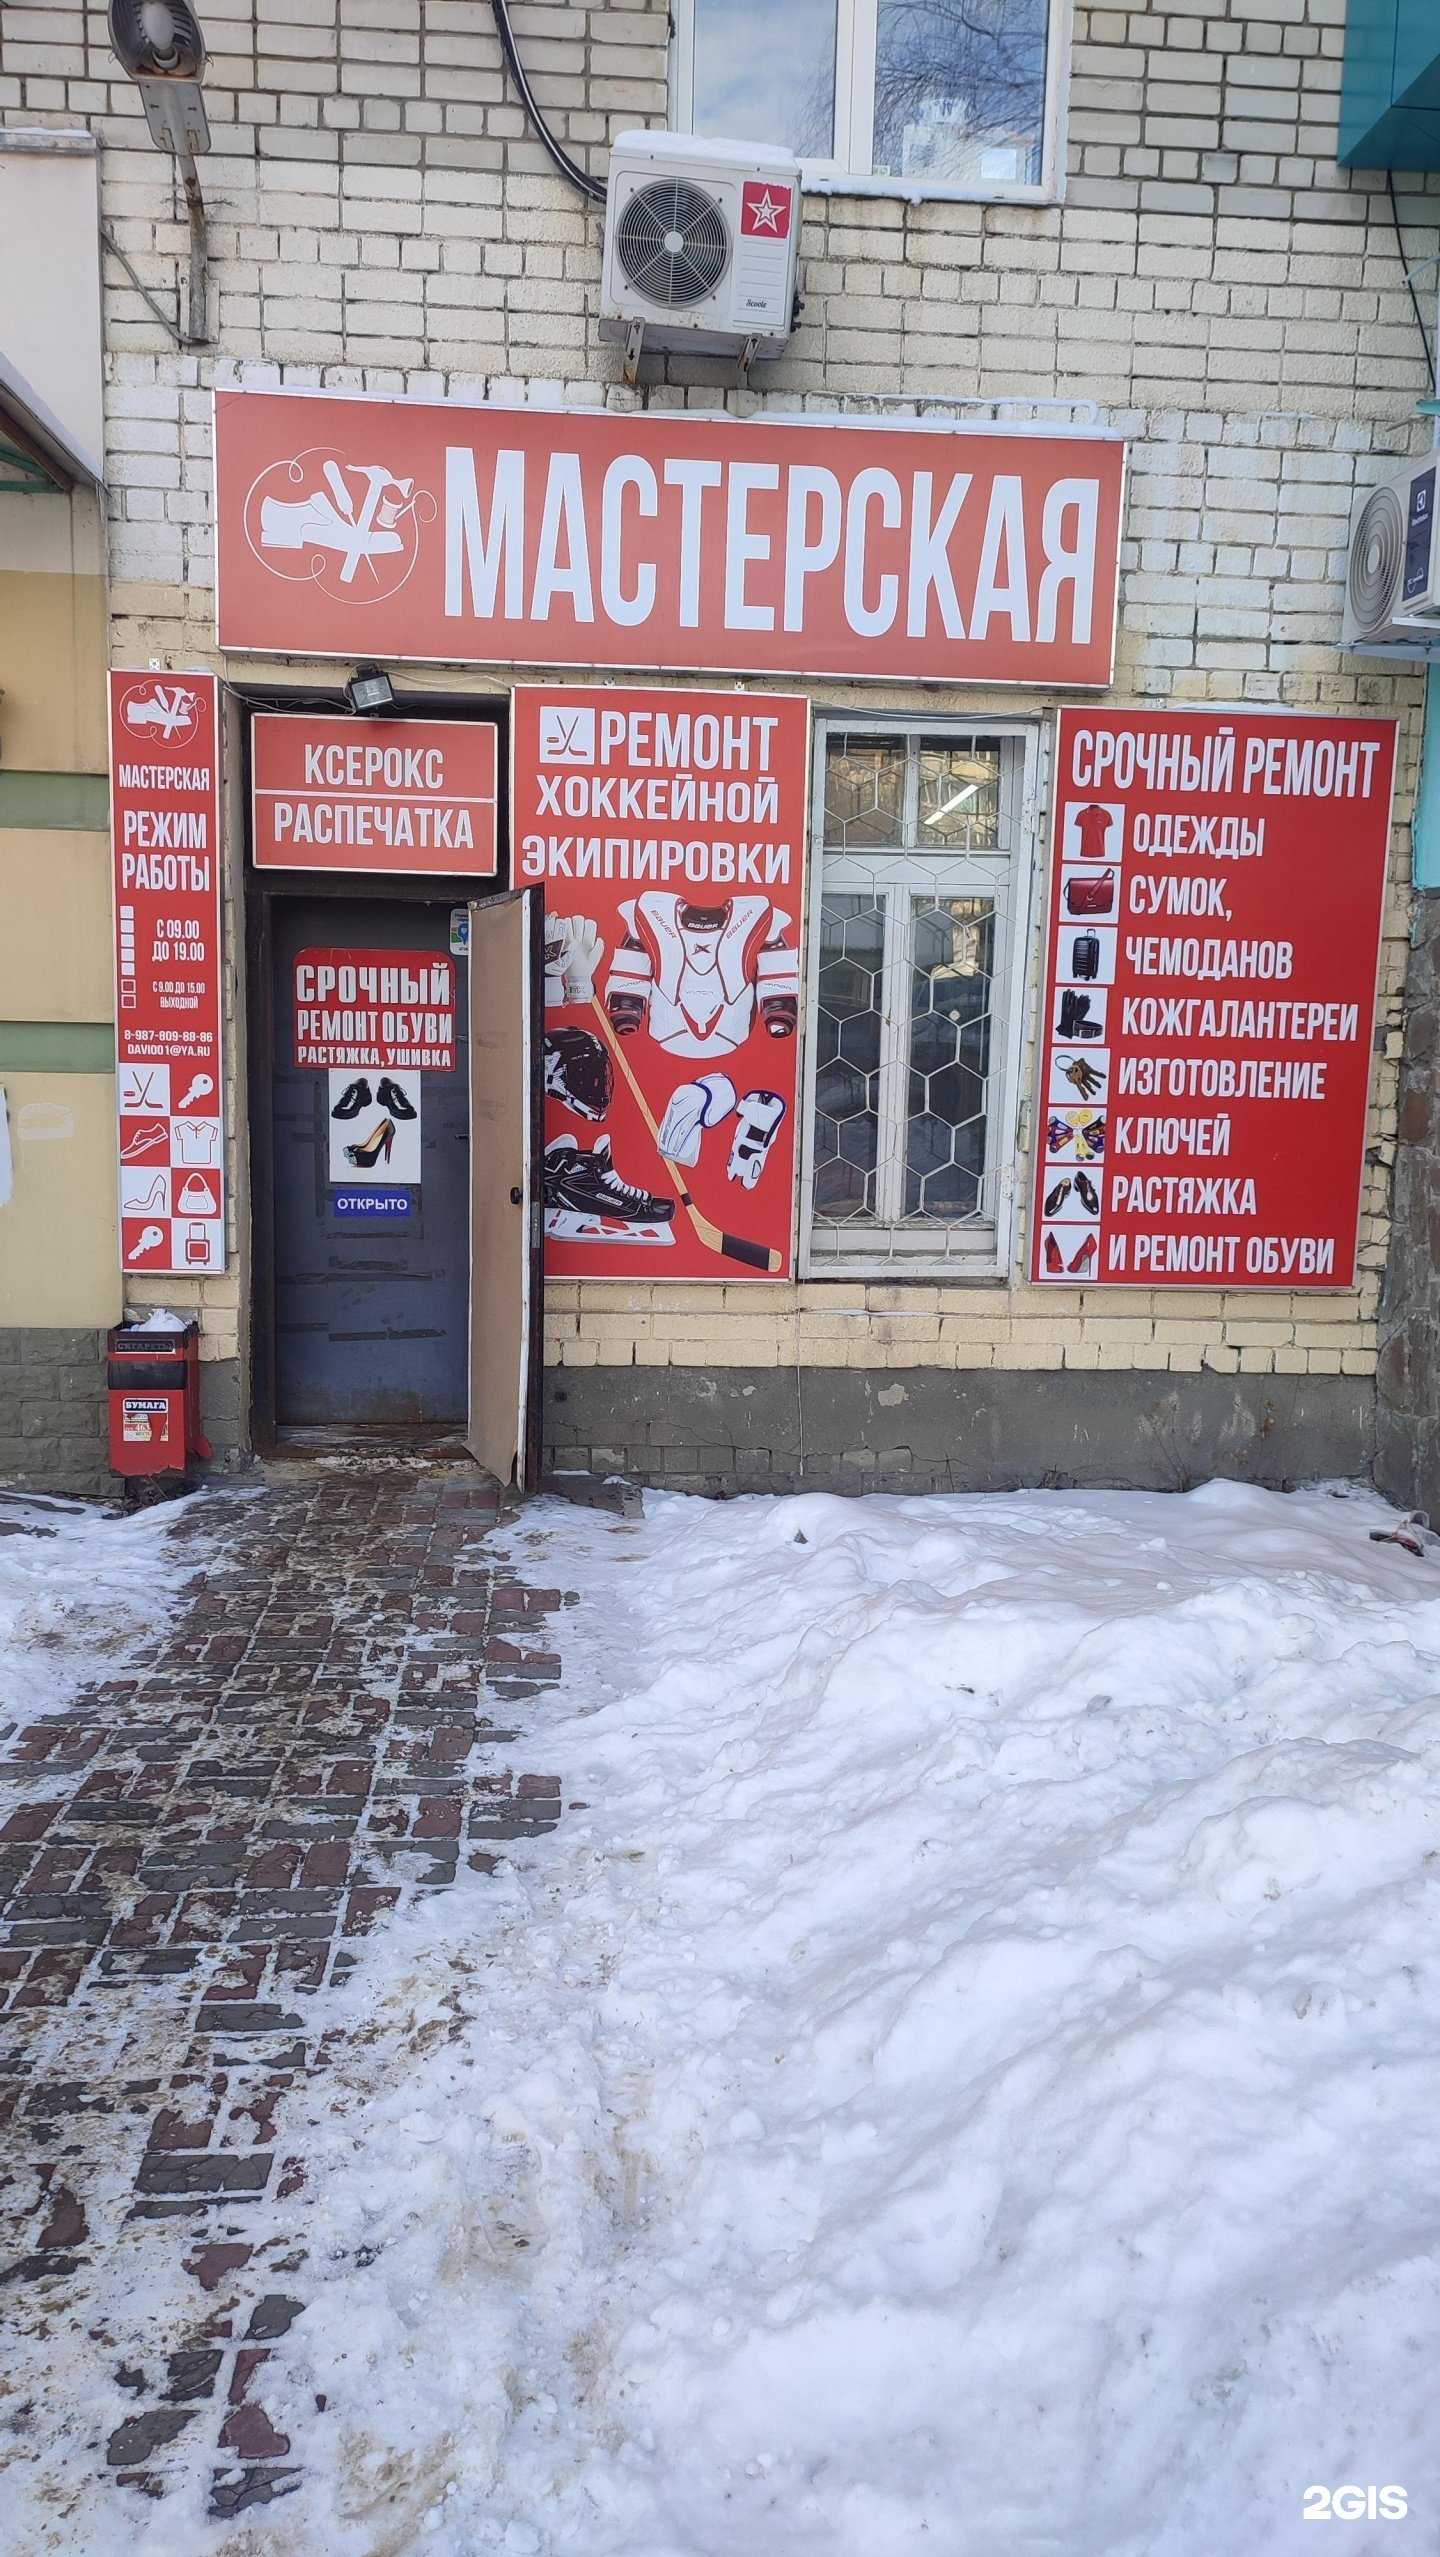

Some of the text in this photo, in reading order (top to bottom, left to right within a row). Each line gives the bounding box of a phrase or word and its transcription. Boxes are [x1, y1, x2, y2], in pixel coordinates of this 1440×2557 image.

[444, 447, 1099, 645] МАСТЕРСКАЯ
[601, 711, 779, 771] РЕМОНТ
[1071, 727, 1380, 798] СРОЧНЫЙ РЕМОНТ
[119, 764, 210, 791] МАСТЕРСКАЯ
[305, 744, 443, 789] КСЕРОКС
[536, 773, 779, 824] ХОККЕЙНОЙ
[123, 810, 207, 849] РЕЖИМ
[274, 802, 474, 849] РАСПЕЧАТКА
[1133, 813, 1265, 860] ОДЕЖДЫ
[122, 853, 210, 892] РАБОТЫ
[522, 835, 790, 884] ЭКИПИРОВКИ
[1128, 874, 1232, 922] СУМОК,
[156, 919, 200, 939] С 09.00
[152, 941, 205, 962] ДО 19.00
[1125, 936, 1294, 981] ЧЕМОДАНОВ
[158, 981, 174, 993] 9.00
[175, 982, 185, 995] ДО
[187, 982, 206, 994] 15.00
[160, 996, 199, 1009] ВЫХОДНОЙ
[296, 962, 450, 1006] СРОЧНЫЙ
[297, 1009, 453, 1044] РЕМОНТ ОБУВИ
[1121, 996, 1359, 1042] КОЖГАЛАНТЕРЕИ
[297, 1046, 451, 1067] РАСТЯЖКА, УШИВКА
[1118, 1057, 1328, 1100] ИЗГОТОВЛЕНИЕ
[1114, 1113, 1231, 1156] КЛЮЧЕЙ
[337, 1198, 408, 1210] ОТКРЫТО
[1111, 1175, 1257, 1216] РАСТЯЖКА
[1108, 1234, 1335, 1275] И РЕМОНТ ОБУВИ
[126, 1401, 166, 1410] БУМАГА
